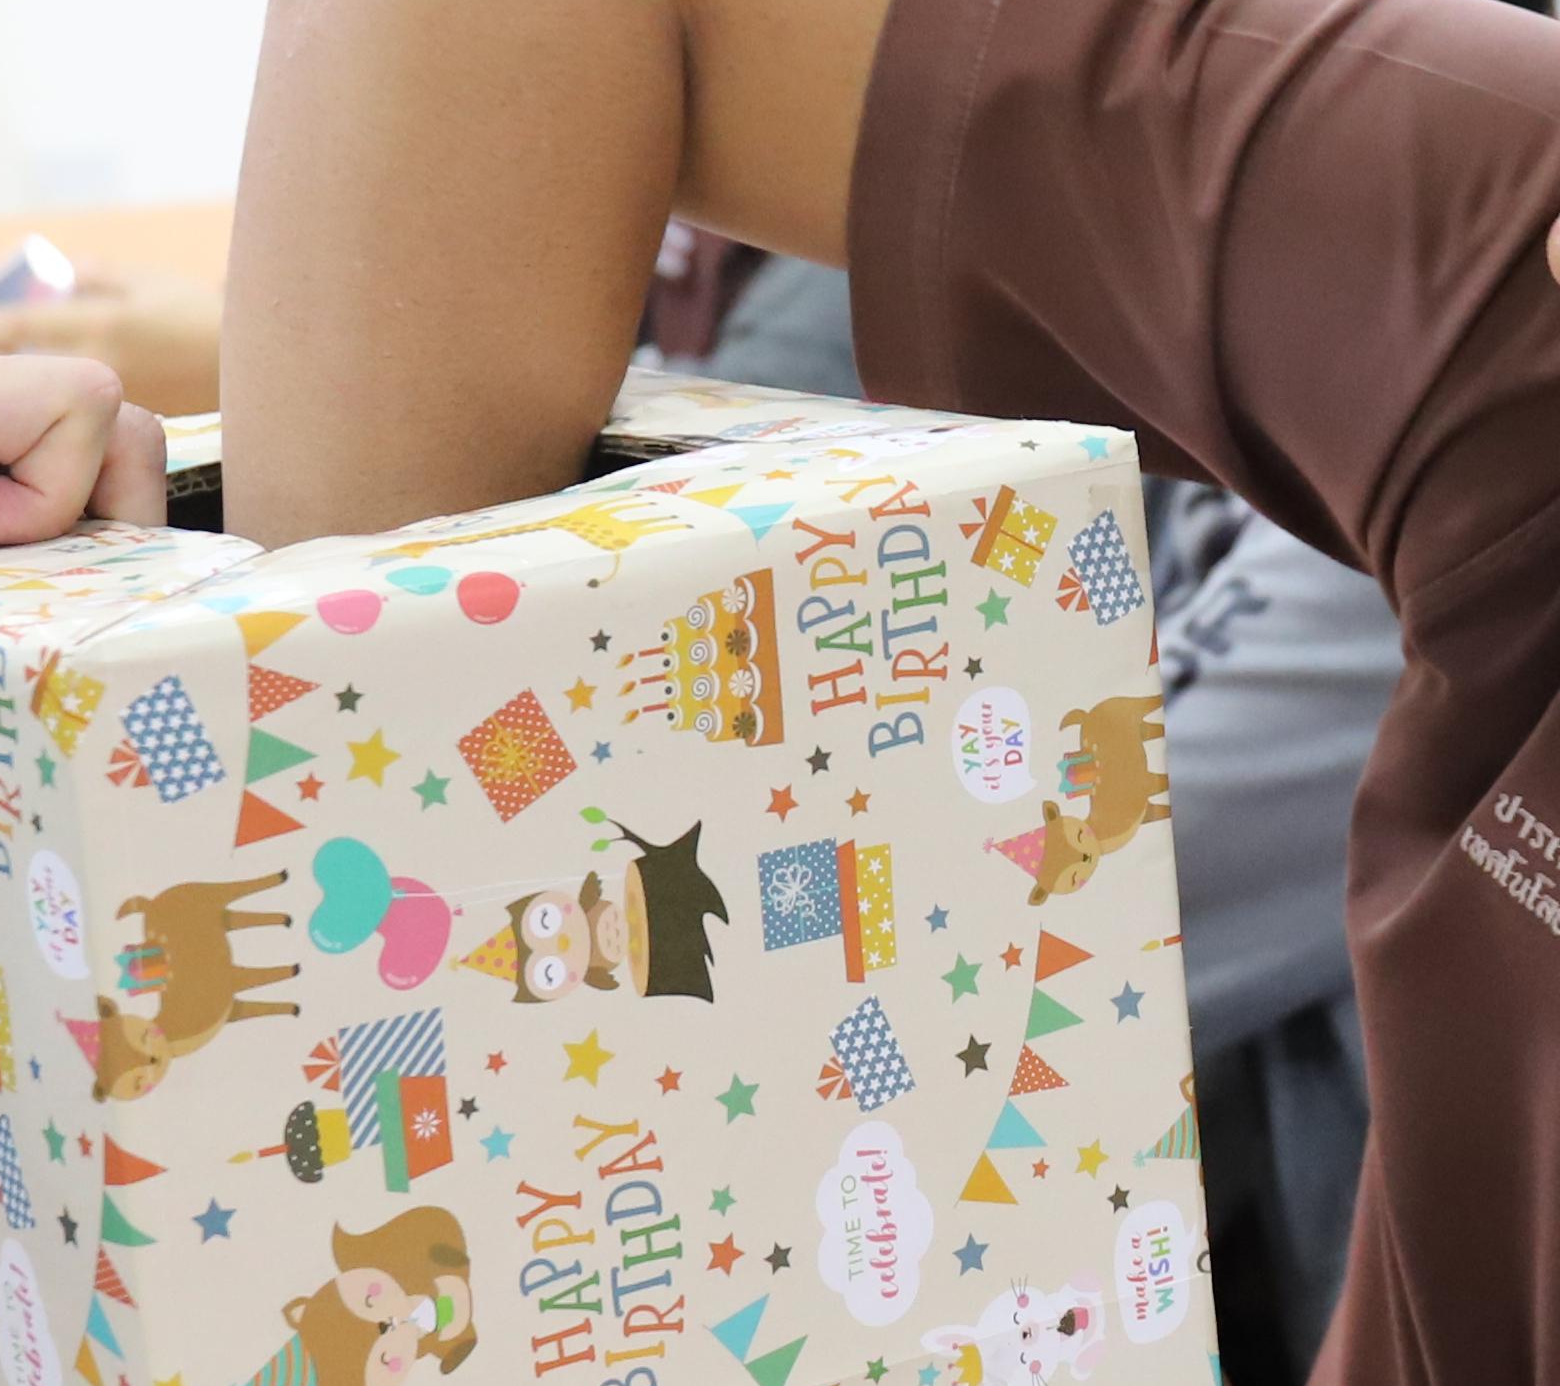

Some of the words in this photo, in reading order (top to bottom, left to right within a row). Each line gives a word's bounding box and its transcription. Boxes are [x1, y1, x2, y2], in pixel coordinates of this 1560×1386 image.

[793, 517, 874, 716] HAPPY
[824, 474, 949, 758] BIRTHDAY
[957, 722, 983, 774] YAY
[981, 702, 1004, 749] your
[1000, 717, 1024, 766] DAY
[840, 1174, 859, 1210] TO
[856, 1149, 899, 1299] celebrate!
[845, 1217, 865, 1282] TIME
[1131, 1232, 1142, 1250] a
[1146, 1225, 1175, 1314] WISH!
[516, 1180, 603, 1378] HAPPY
[1127, 1257, 1150, 1321] make
